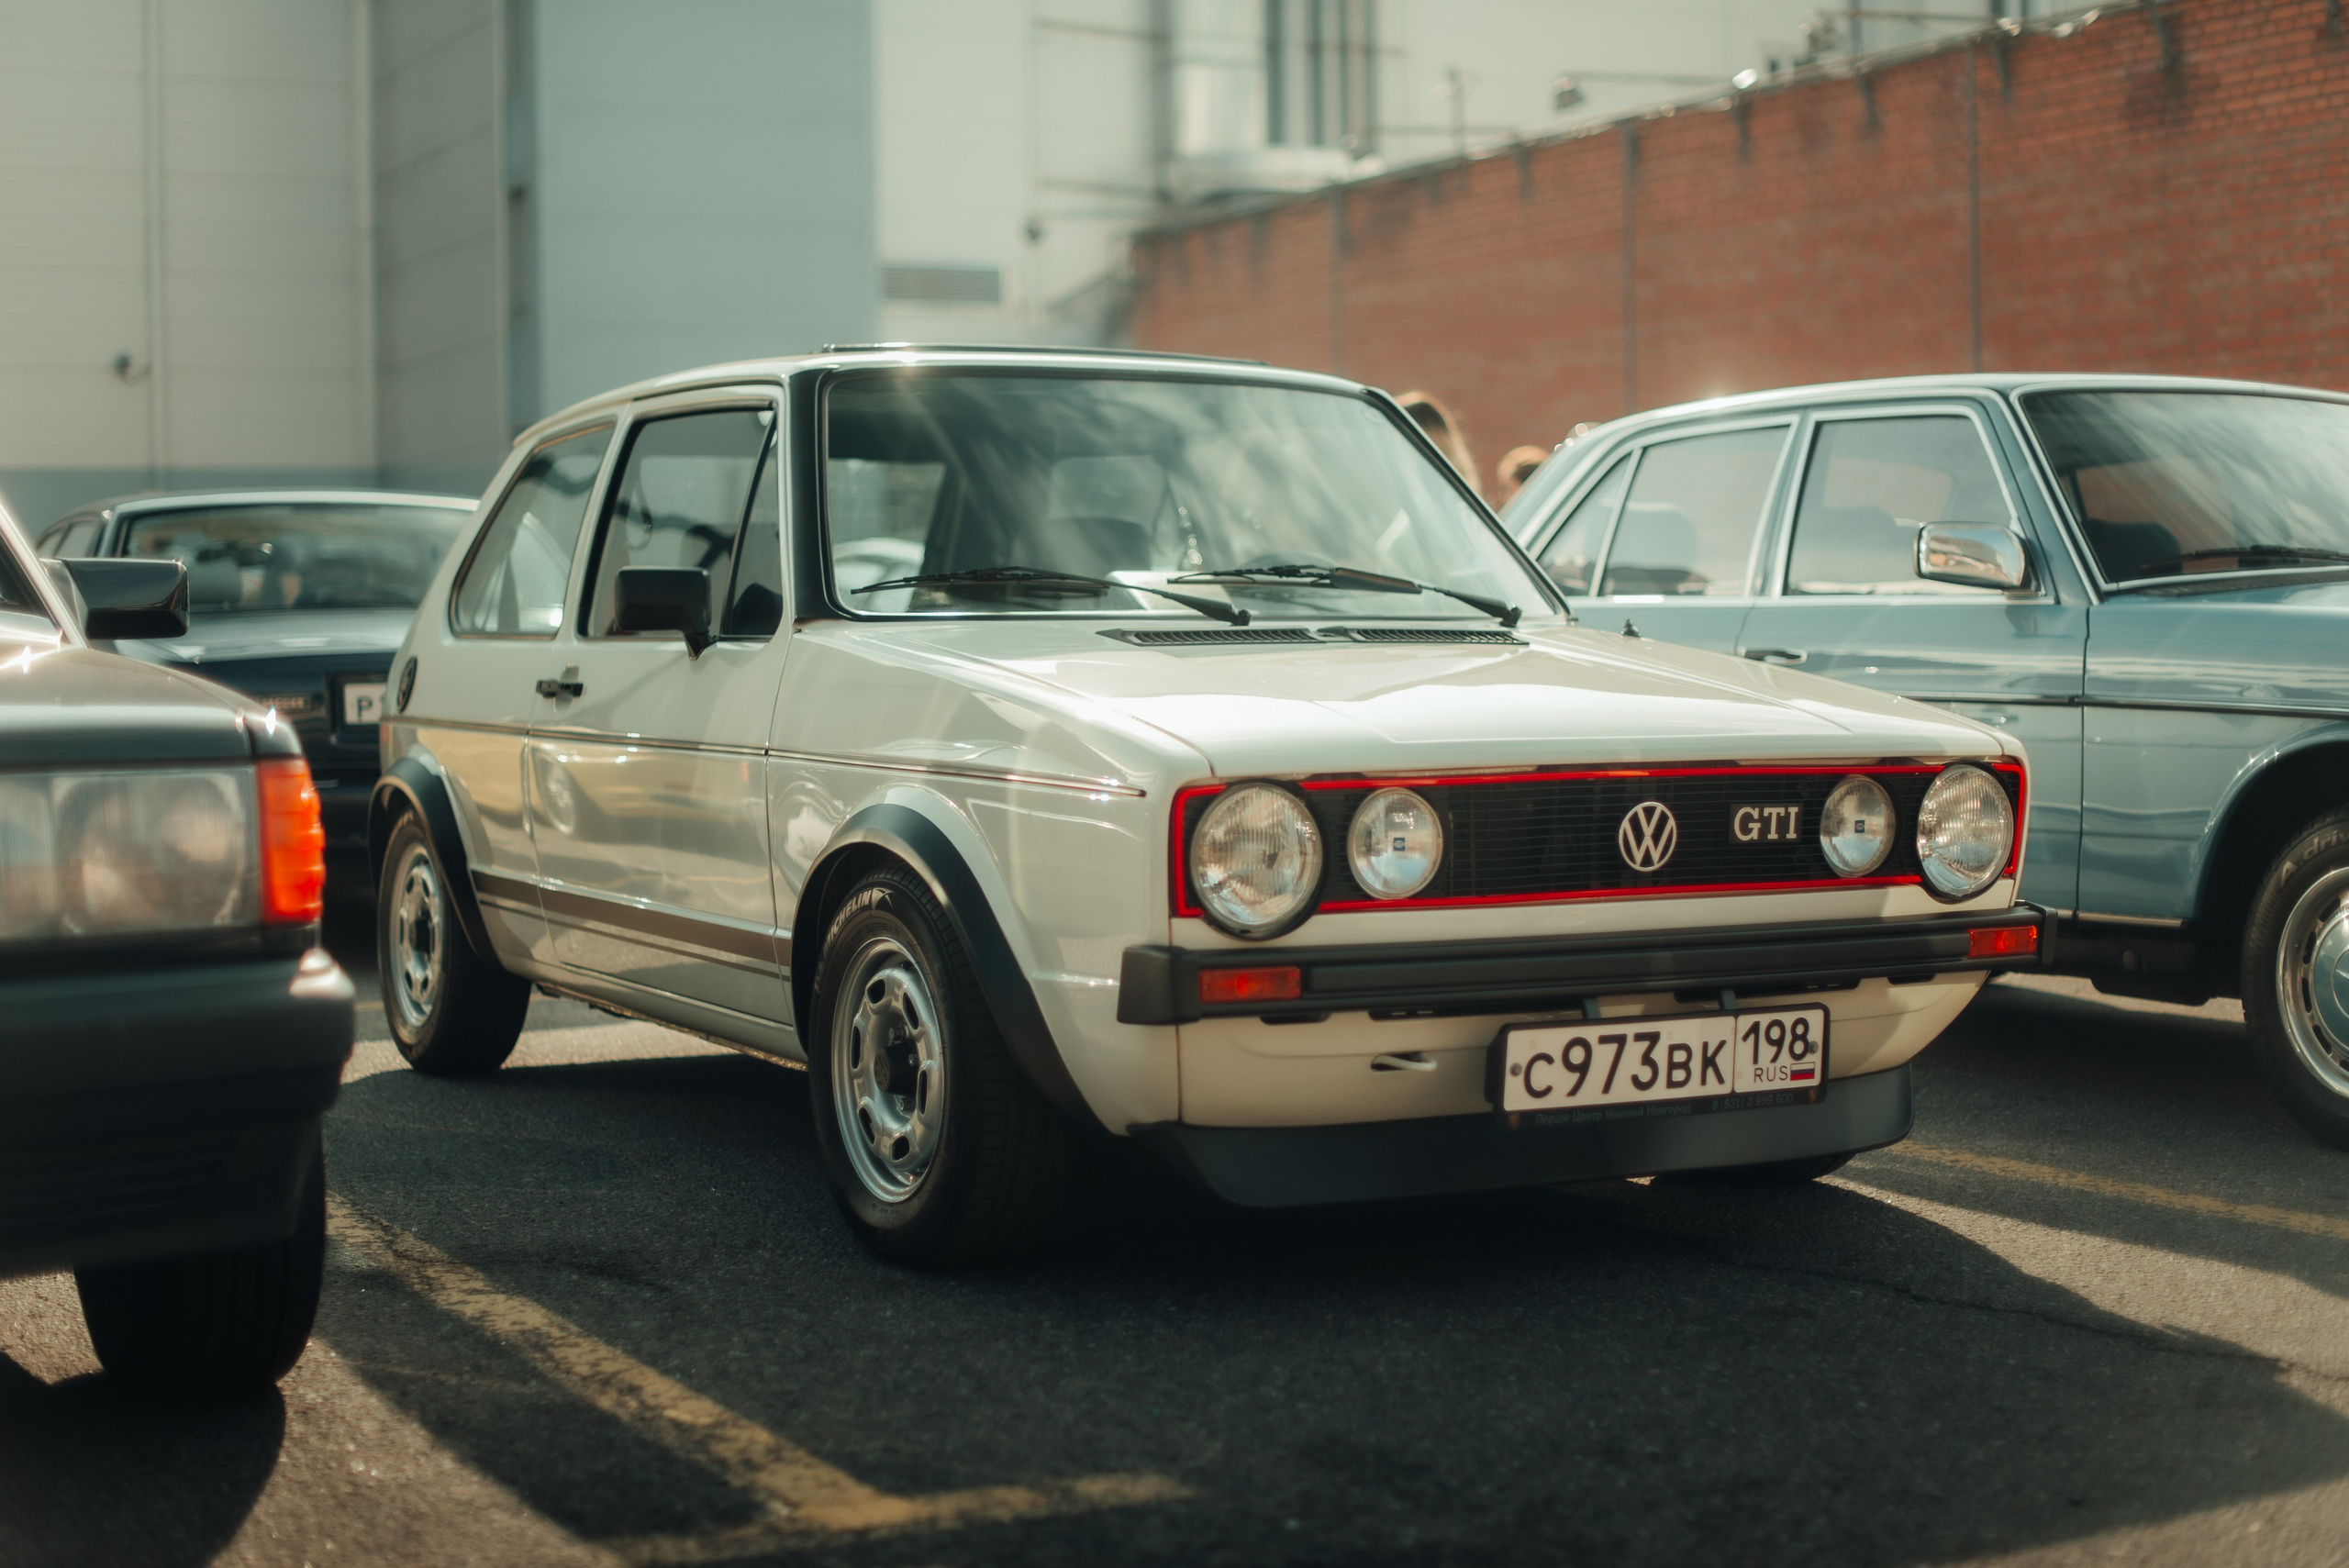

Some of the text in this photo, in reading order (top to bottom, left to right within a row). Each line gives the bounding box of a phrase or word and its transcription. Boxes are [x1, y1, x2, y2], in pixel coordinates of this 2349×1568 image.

[1733, 806, 1799, 841] GTI
[822, 888, 874, 961] MICHELIN
[1741, 1017, 1810, 1065] 198
[1753, 1064, 1788, 1084] RUS
[1535, 1105, 1691, 1125] Порше Центр Нижний Новгород
